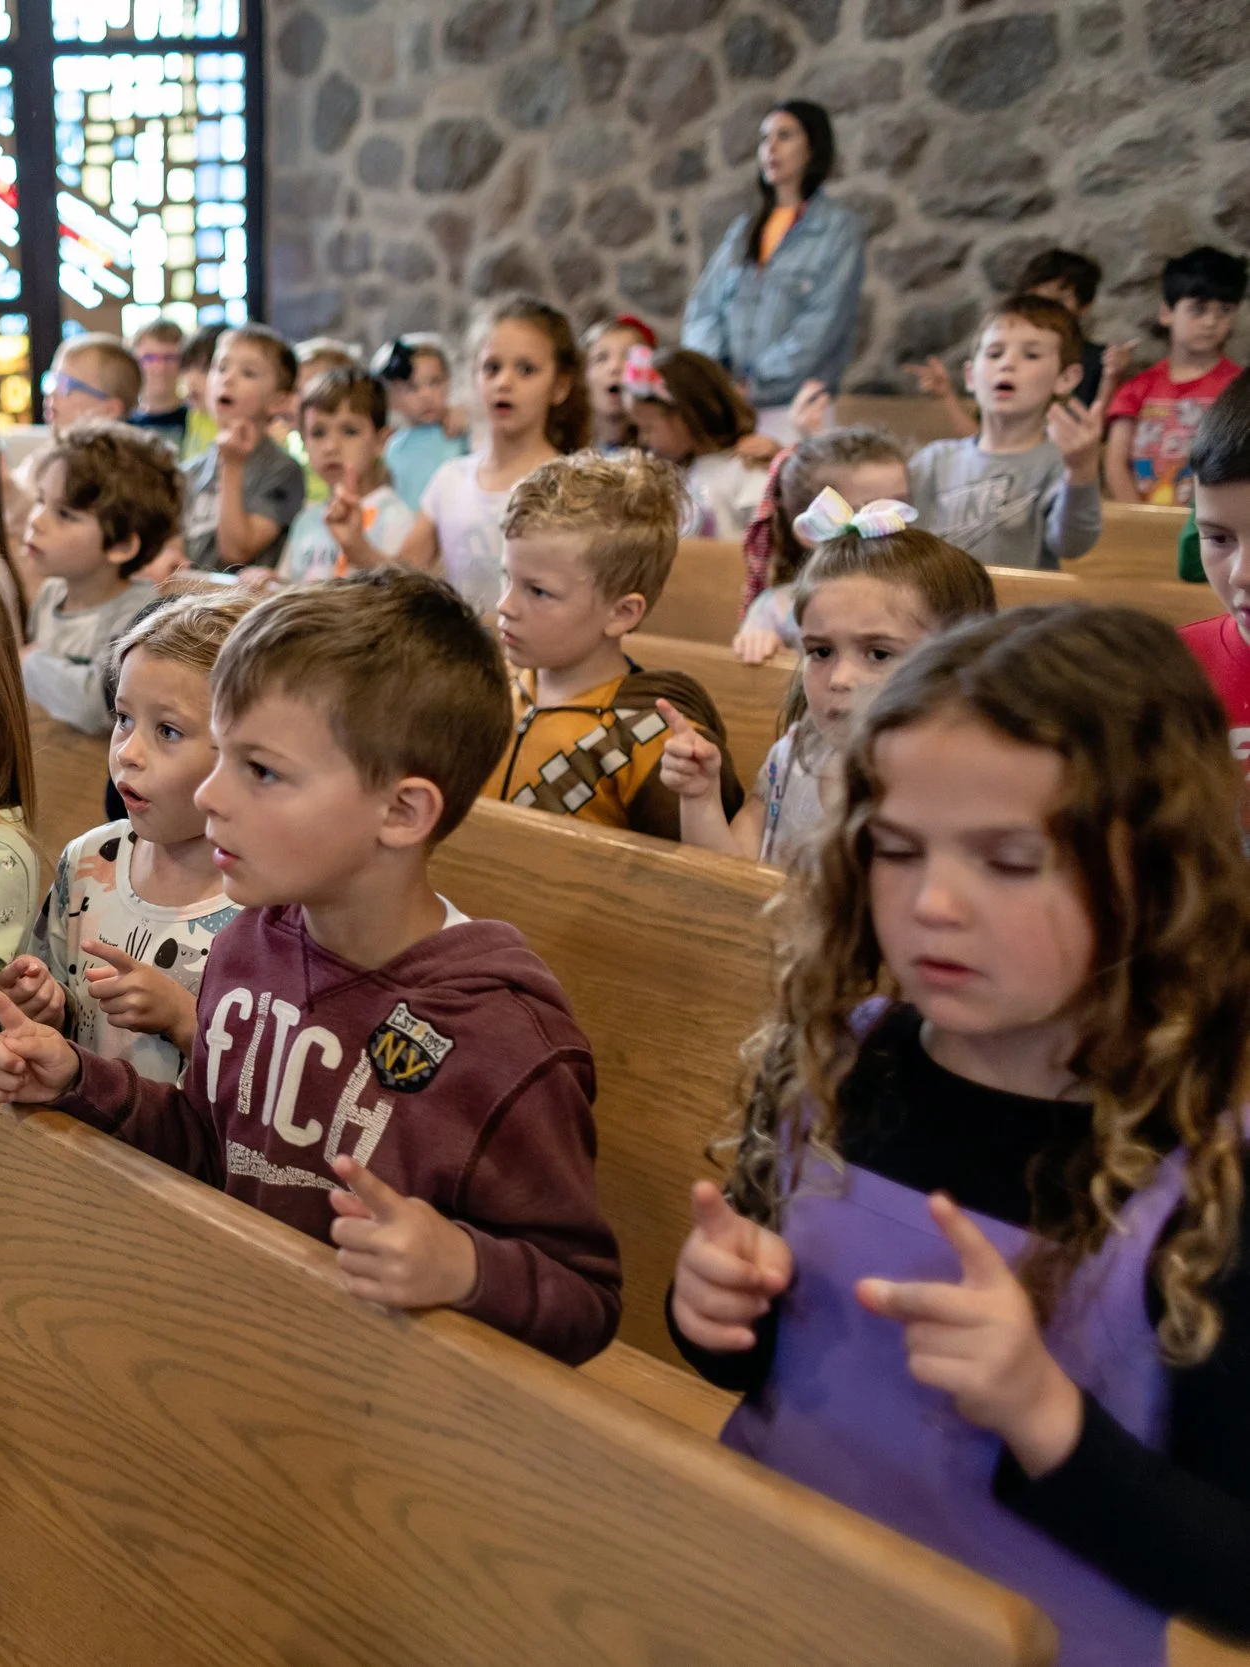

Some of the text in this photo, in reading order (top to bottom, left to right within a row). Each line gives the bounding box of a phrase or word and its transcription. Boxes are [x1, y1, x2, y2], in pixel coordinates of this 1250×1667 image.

[373, 1030, 429, 1080] NY
[390, 1006, 447, 1060] EST 1892
